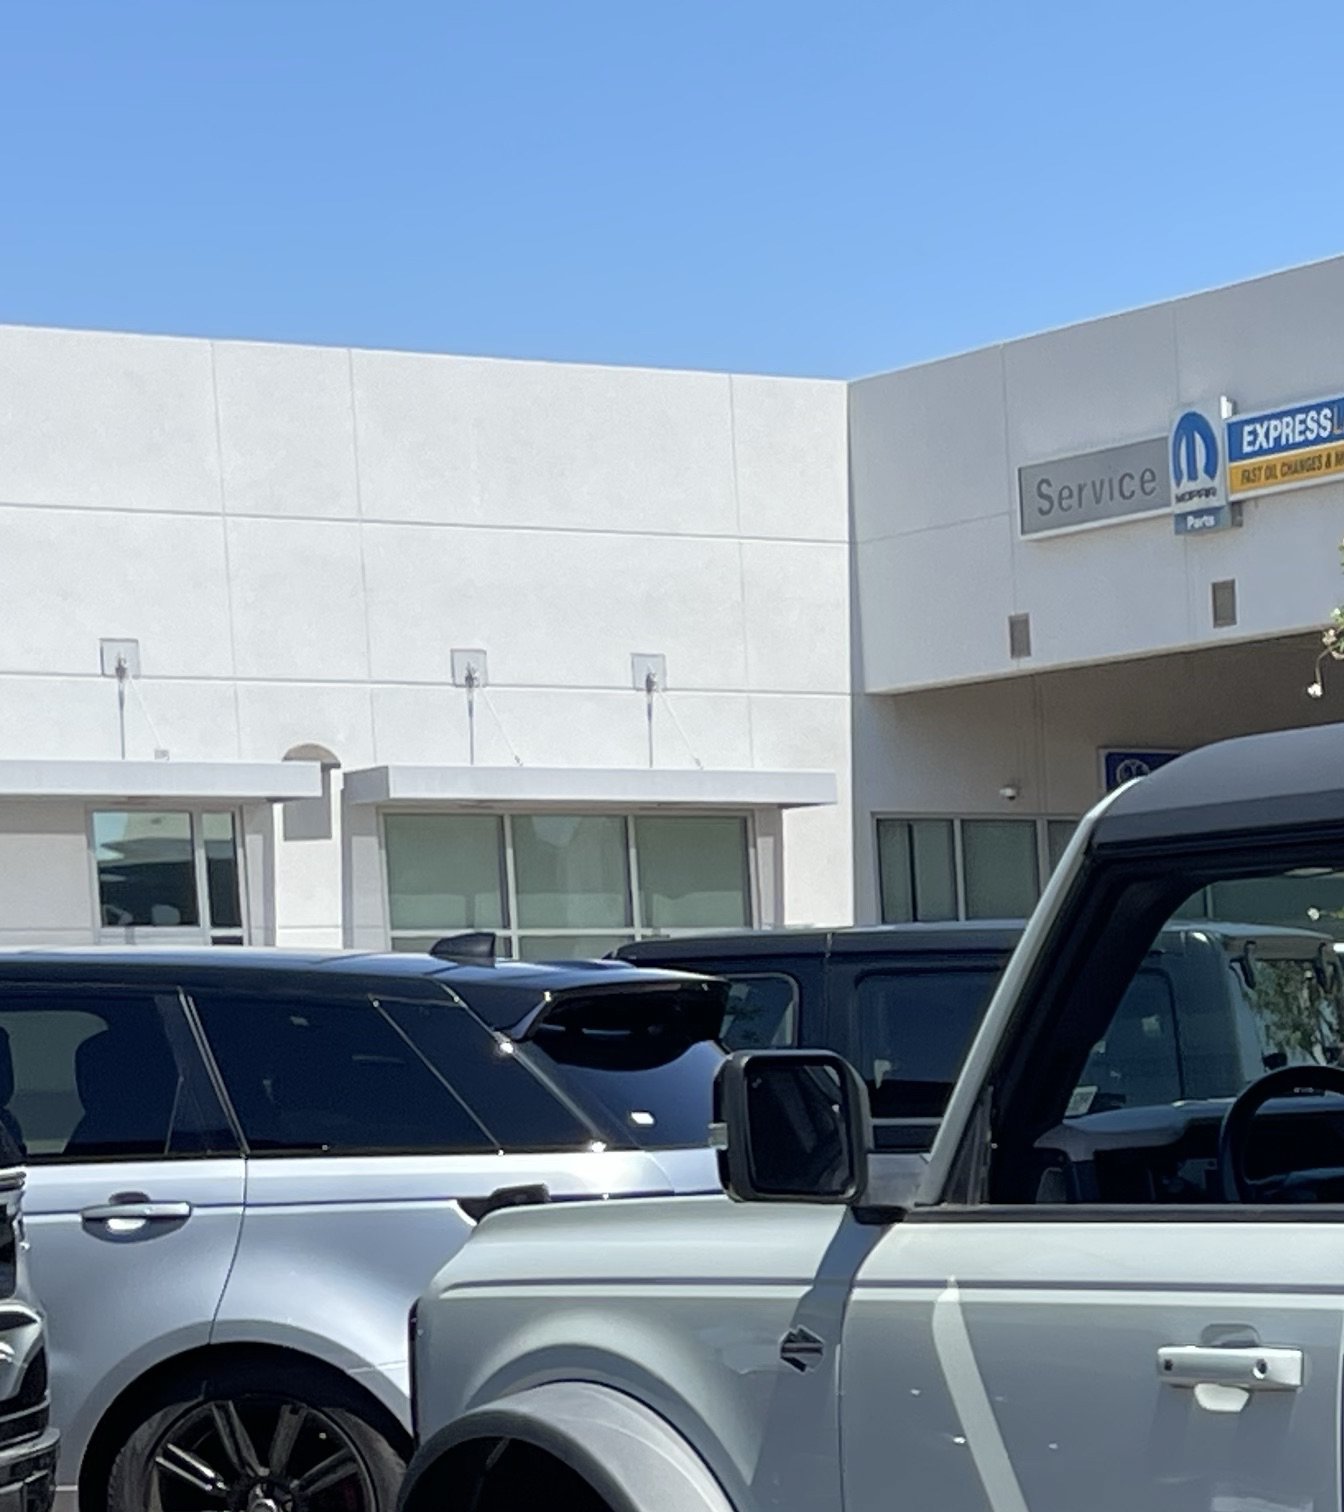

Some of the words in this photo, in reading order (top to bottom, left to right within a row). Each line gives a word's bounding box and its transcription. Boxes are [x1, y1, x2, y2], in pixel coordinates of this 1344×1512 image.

[1241, 467, 1263, 486] FAST
[1280, 454, 1323, 477] CHANGES
[1036, 467, 1157, 517] Service
[1186, 513, 1215, 530] Parts
